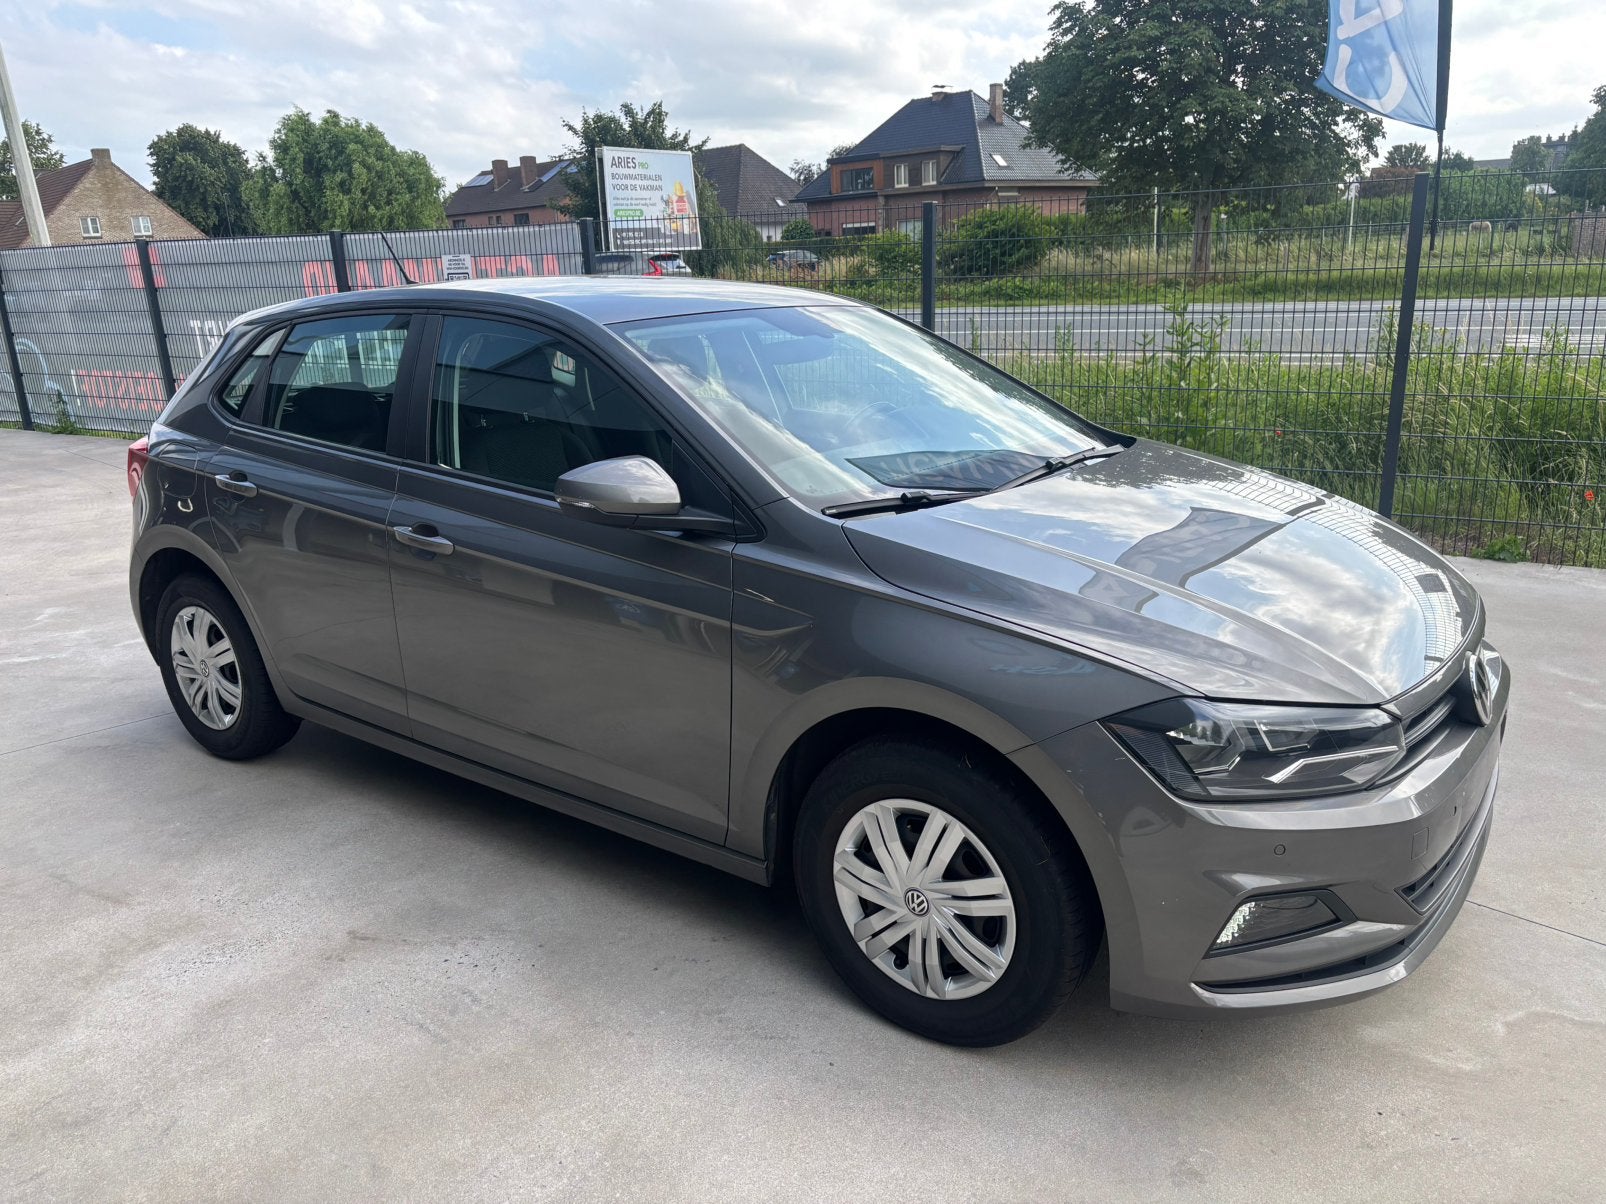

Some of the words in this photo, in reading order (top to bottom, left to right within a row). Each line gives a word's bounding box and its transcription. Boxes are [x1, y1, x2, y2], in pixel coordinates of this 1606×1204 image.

[611, 156, 637, 169] ARIES
[611, 173, 663, 182] BOUWMATERIALEN
[612, 183, 629, 192] VOOR
[630, 183, 638, 192] DE
[640, 184, 663, 192] VAKMAN
